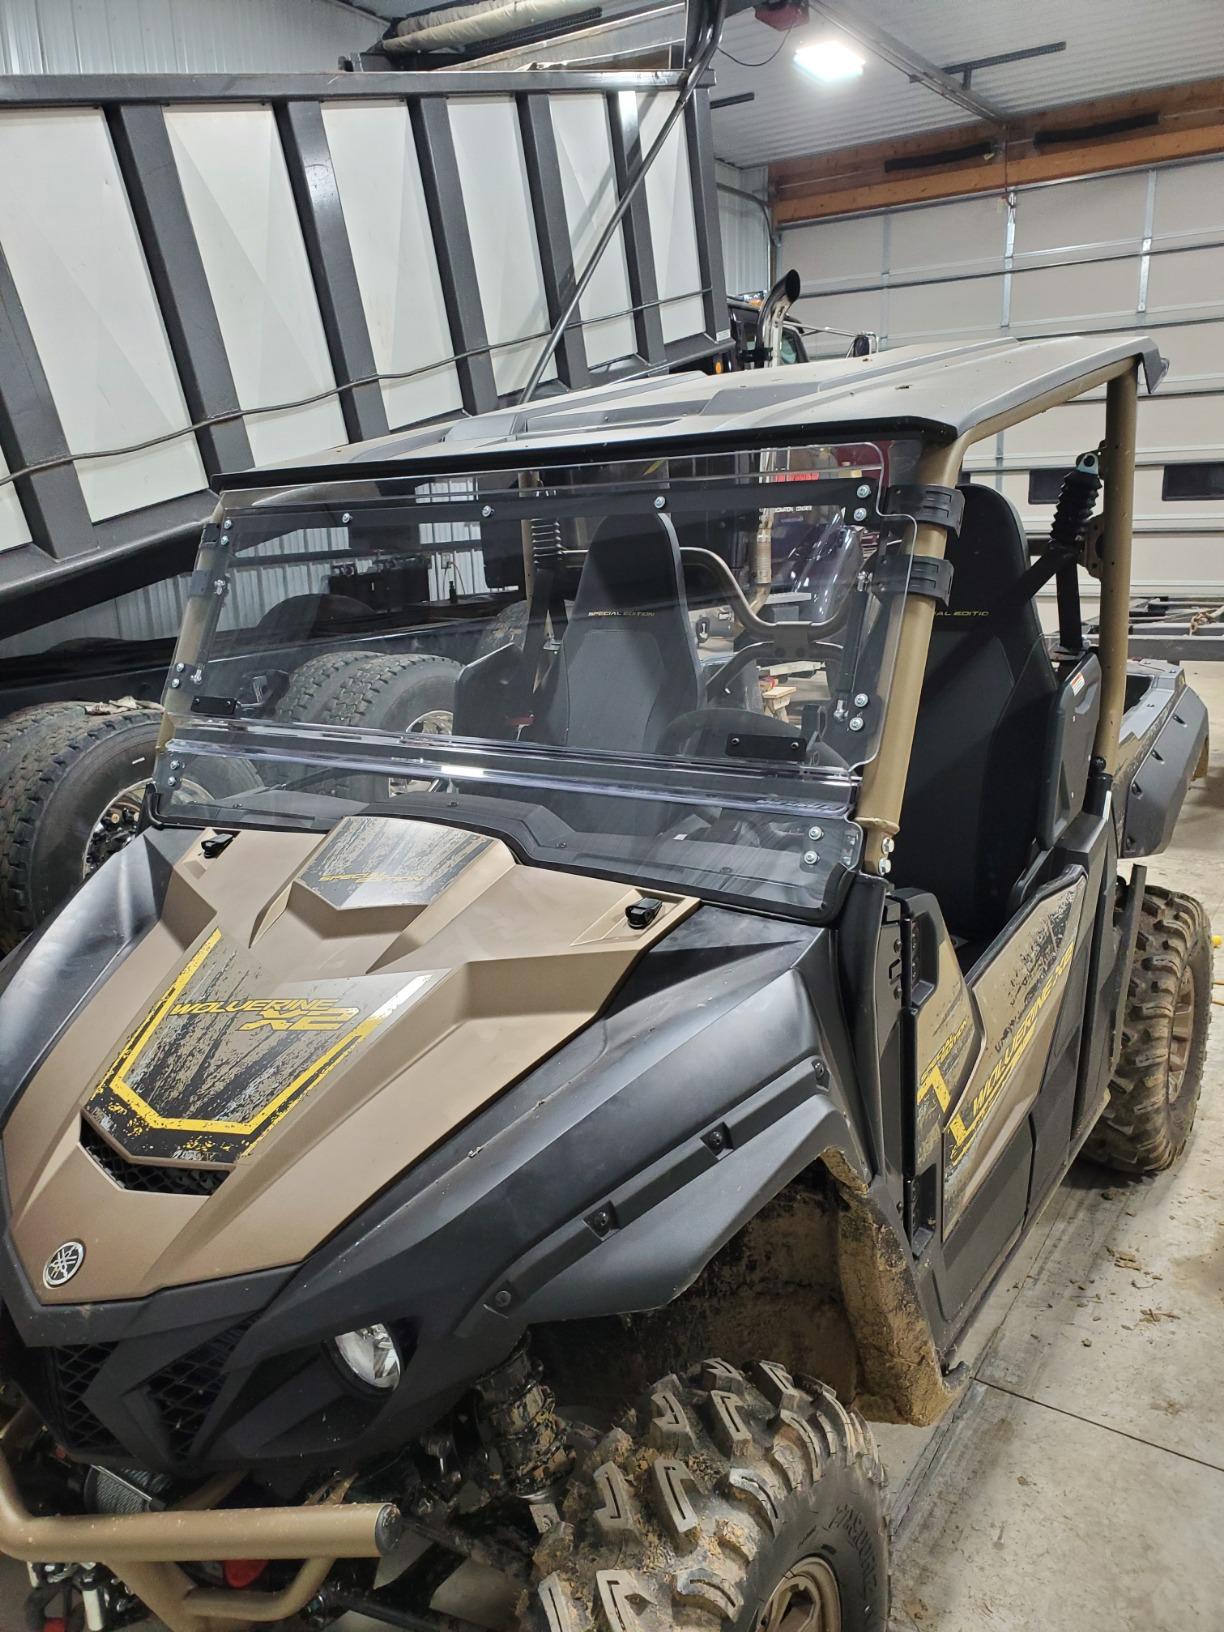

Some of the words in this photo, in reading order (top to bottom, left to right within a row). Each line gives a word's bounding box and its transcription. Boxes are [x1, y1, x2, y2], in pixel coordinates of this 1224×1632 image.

[168, 999, 340, 1016] WOLVERINE
[236, 1007, 360, 1031] X2
[973, 975, 1058, 1117] WOLVERINE
